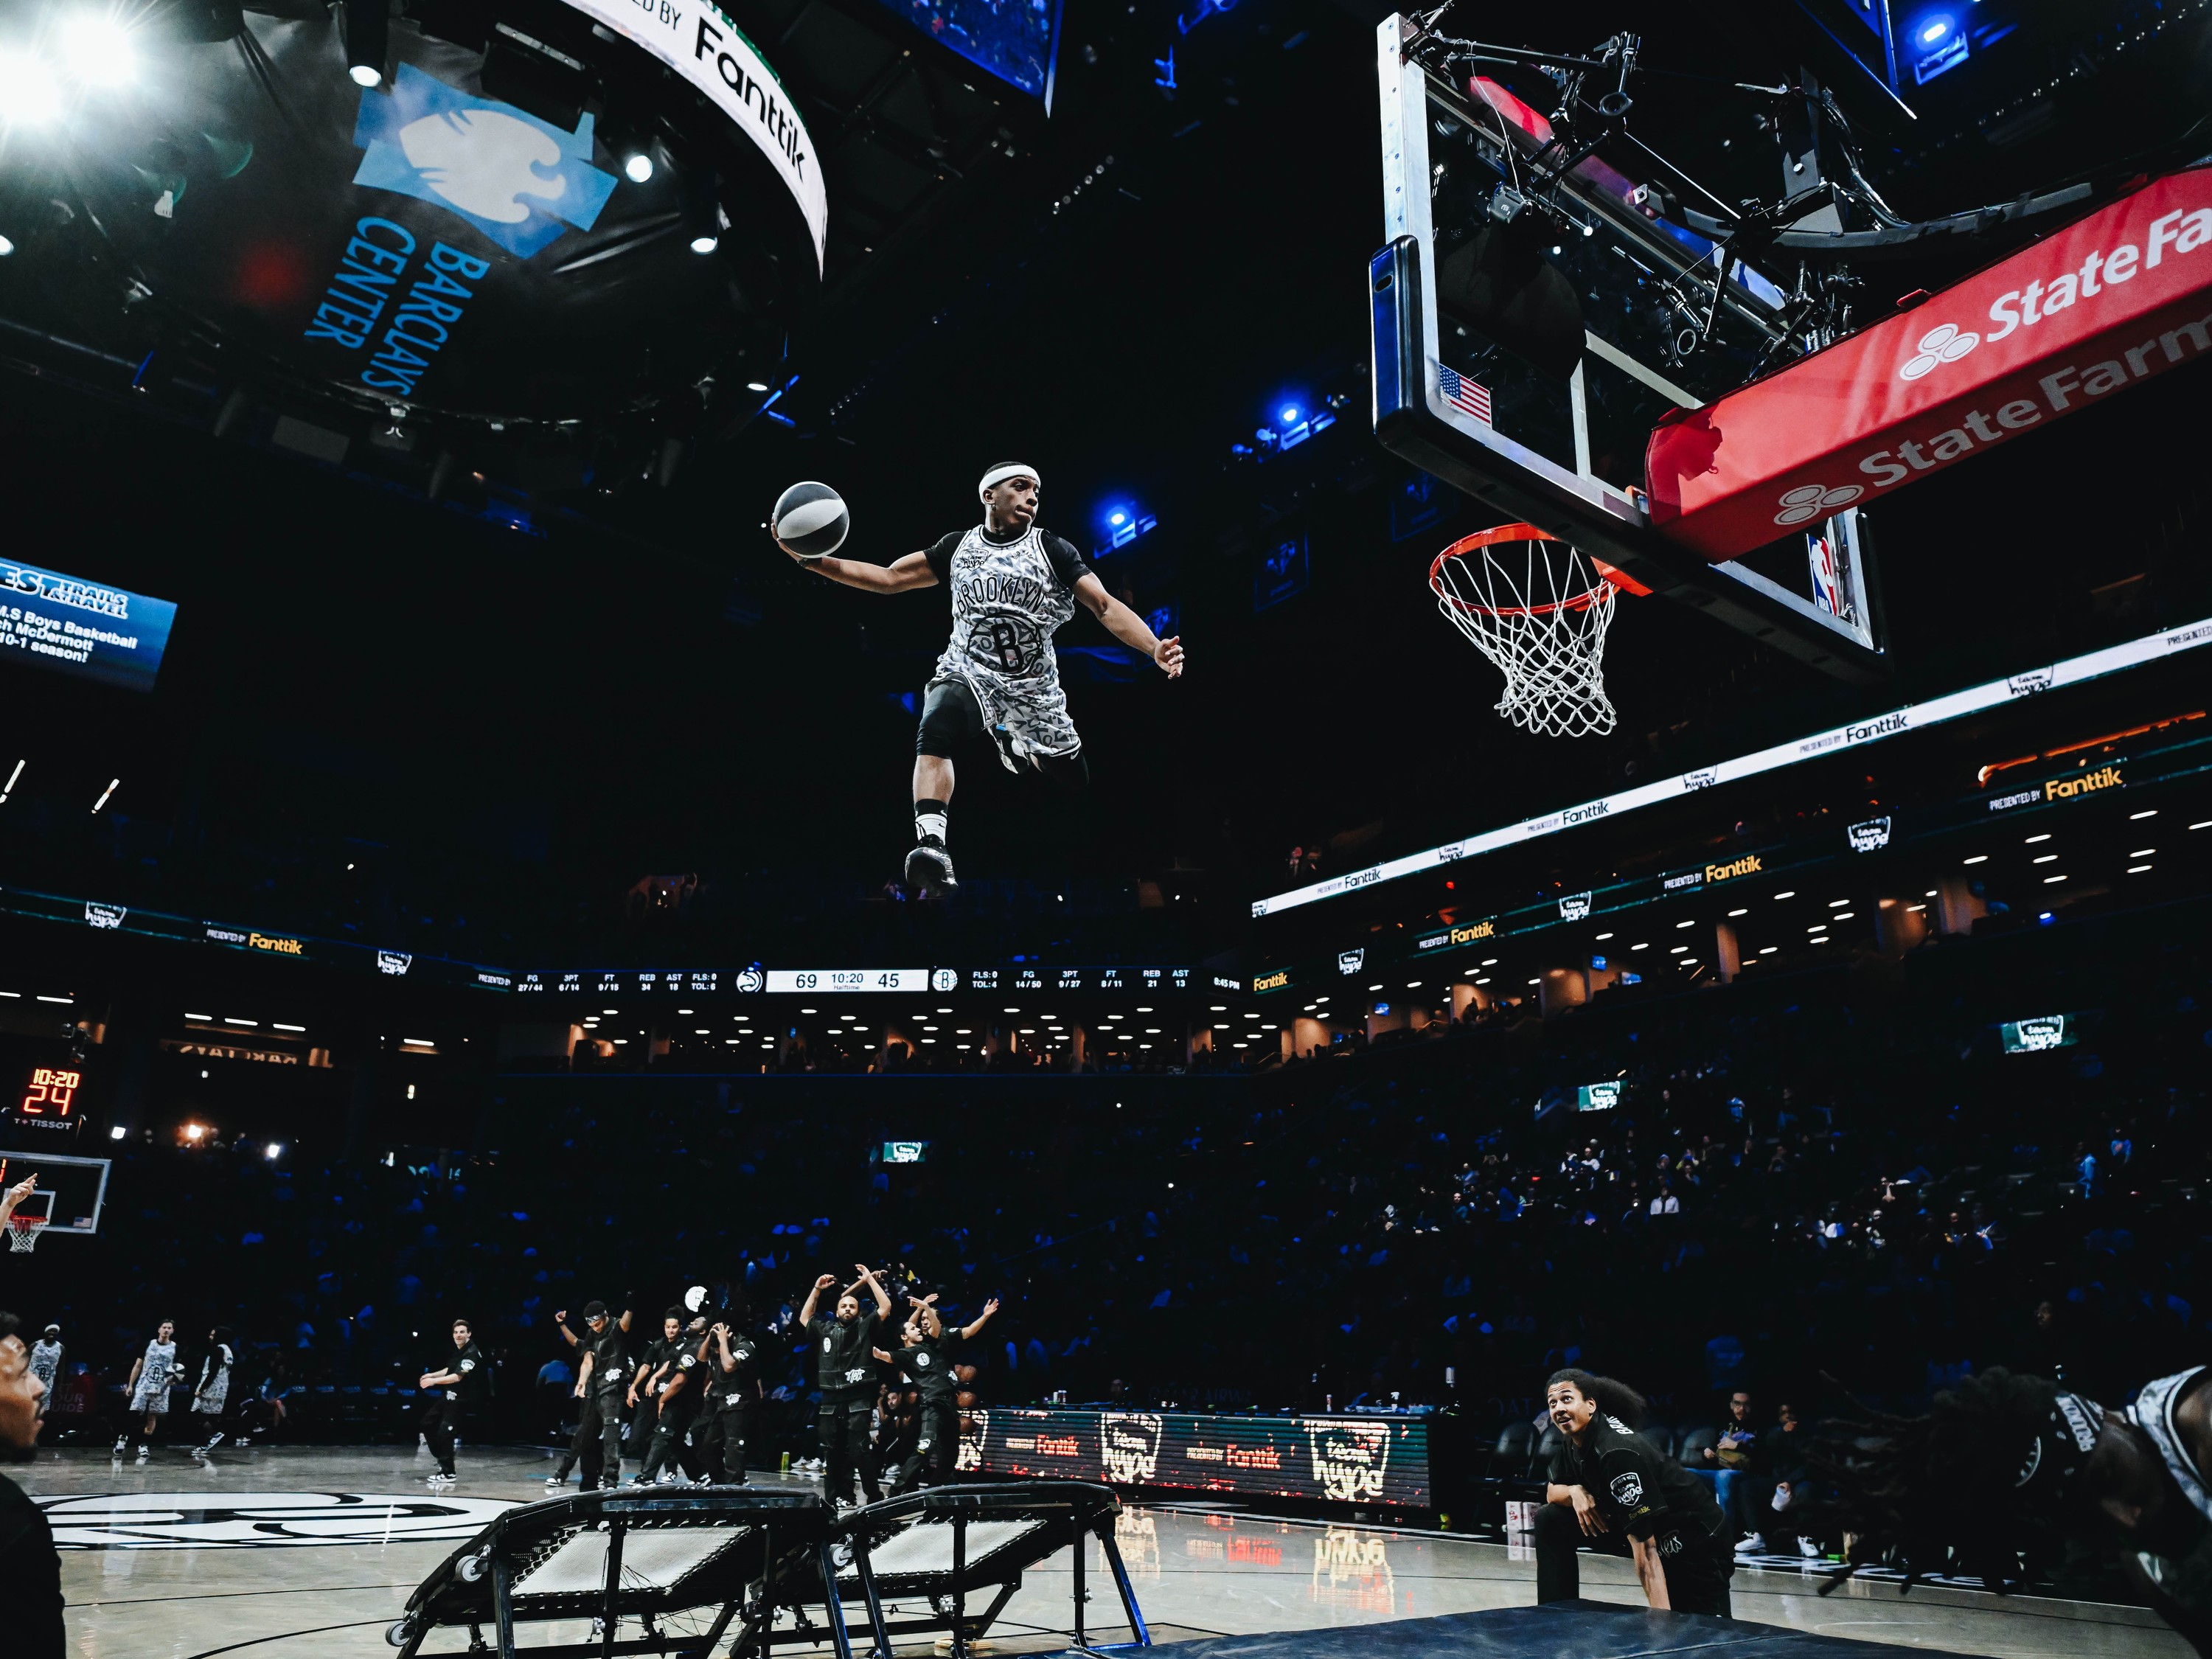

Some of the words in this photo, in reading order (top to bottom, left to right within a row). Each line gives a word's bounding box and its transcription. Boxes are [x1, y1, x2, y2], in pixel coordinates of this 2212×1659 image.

[659, 3, 681, 31] BY
[695, 15, 805, 185] Fanttik
[2145, 207, 2212, 271] Fa
[303, 216, 417, 350] CENTER
[361, 240, 491, 396] BARCLAYS
[61, 580, 130, 607] TRAILS
[956, 576, 1047, 616] BROOKLYN
[1817, 594, 1831, 613] NBA
[15, 622, 95, 653] McDermott
[24, 611, 63, 631] Boys
[63, 620, 139, 650] Basketball
[30, 639, 89, 664] season!
[990, 622, 1025, 674] B
[1846, 714, 1908, 742] Fanttik
[1989, 792, 2030, 811] PRESENTED
[2045, 766, 2124, 801] Fanttik
[1562, 801, 1610, 825] Fanttik
[1344, 868, 1382, 889] Fanttik
[1705, 855, 1762, 883] Fanttik
[248, 932, 303, 955] Fanttik
[1450, 921, 1495, 945] Fanttik
[526, 974, 538, 982] FG
[563, 974, 579, 982] 3PT
[604, 973, 615, 981] FT
[639, 973, 656, 981] REB
[666, 973, 683, 981] AST
[796, 973, 818, 989] 69
[831, 973, 864, 984] 10:20
[877, 973, 900, 988] 45
[941, 971, 949, 989] B
[1023, 970, 1034, 978] FG
[1062, 970, 1079, 978] 3PT
[1105, 970, 1117, 978] FT
[1143, 970, 1161, 978] REB
[1147, 979, 1158, 987] 21
[1175, 979, 1186, 987] 13
[1228, 979, 1240, 990] PM
[1253, 971, 1288, 992] Fanttik
[641, 983, 651, 991] 34
[669, 983, 679, 991] 18
[2020, 1031, 2062, 1050] hype
[32, 1068, 80, 1089] 10:20
[23, 1084, 72, 1116] 24
[29, 1119, 73, 1130] TISSOT
[1312, 1459, 1385, 1502] hype
[1618, 1486, 1644, 1503] hype
